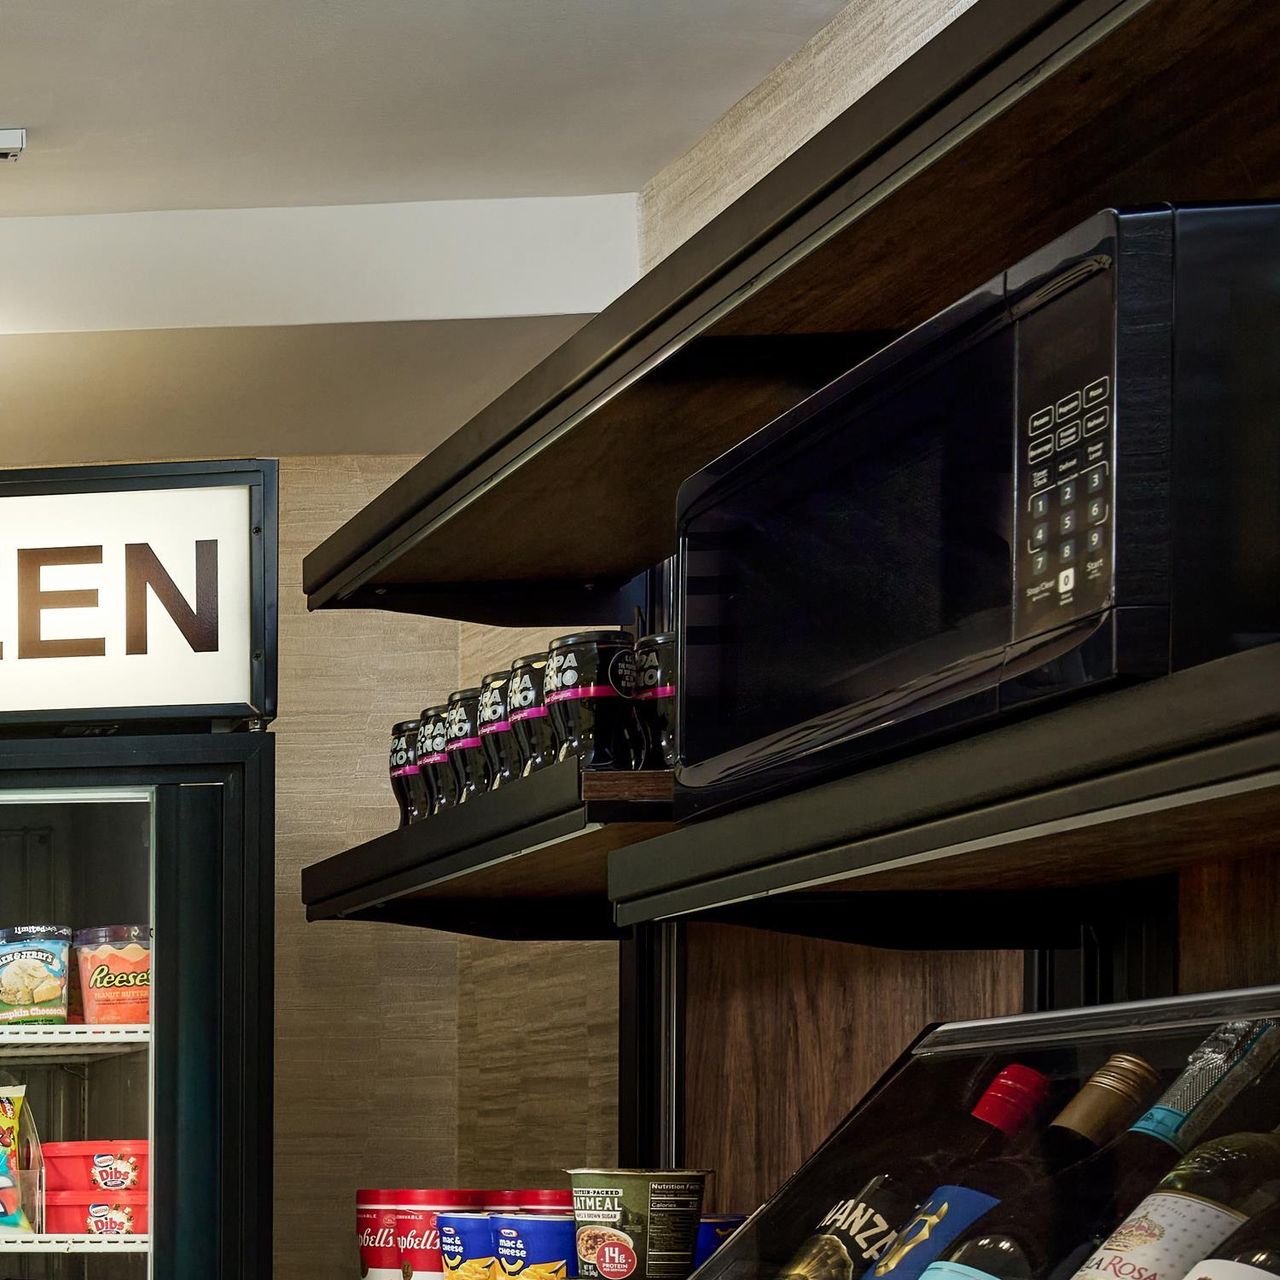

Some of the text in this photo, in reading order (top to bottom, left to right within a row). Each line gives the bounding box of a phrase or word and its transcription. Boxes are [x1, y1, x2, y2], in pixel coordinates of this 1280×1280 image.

[1092, 474, 1099, 486] 3
[1064, 516, 1071, 529] 5
[1091, 533, 1098, 546] 9
[1063, 546, 1070, 558] 8
[1063, 575, 1070, 586] 0
[99, 1167, 130, 1180] Dibs
[95, 1218, 124, 1231] Dibs
[499, 1240, 523, 1248] mac &
[604, 1247, 625, 1263] 14g
